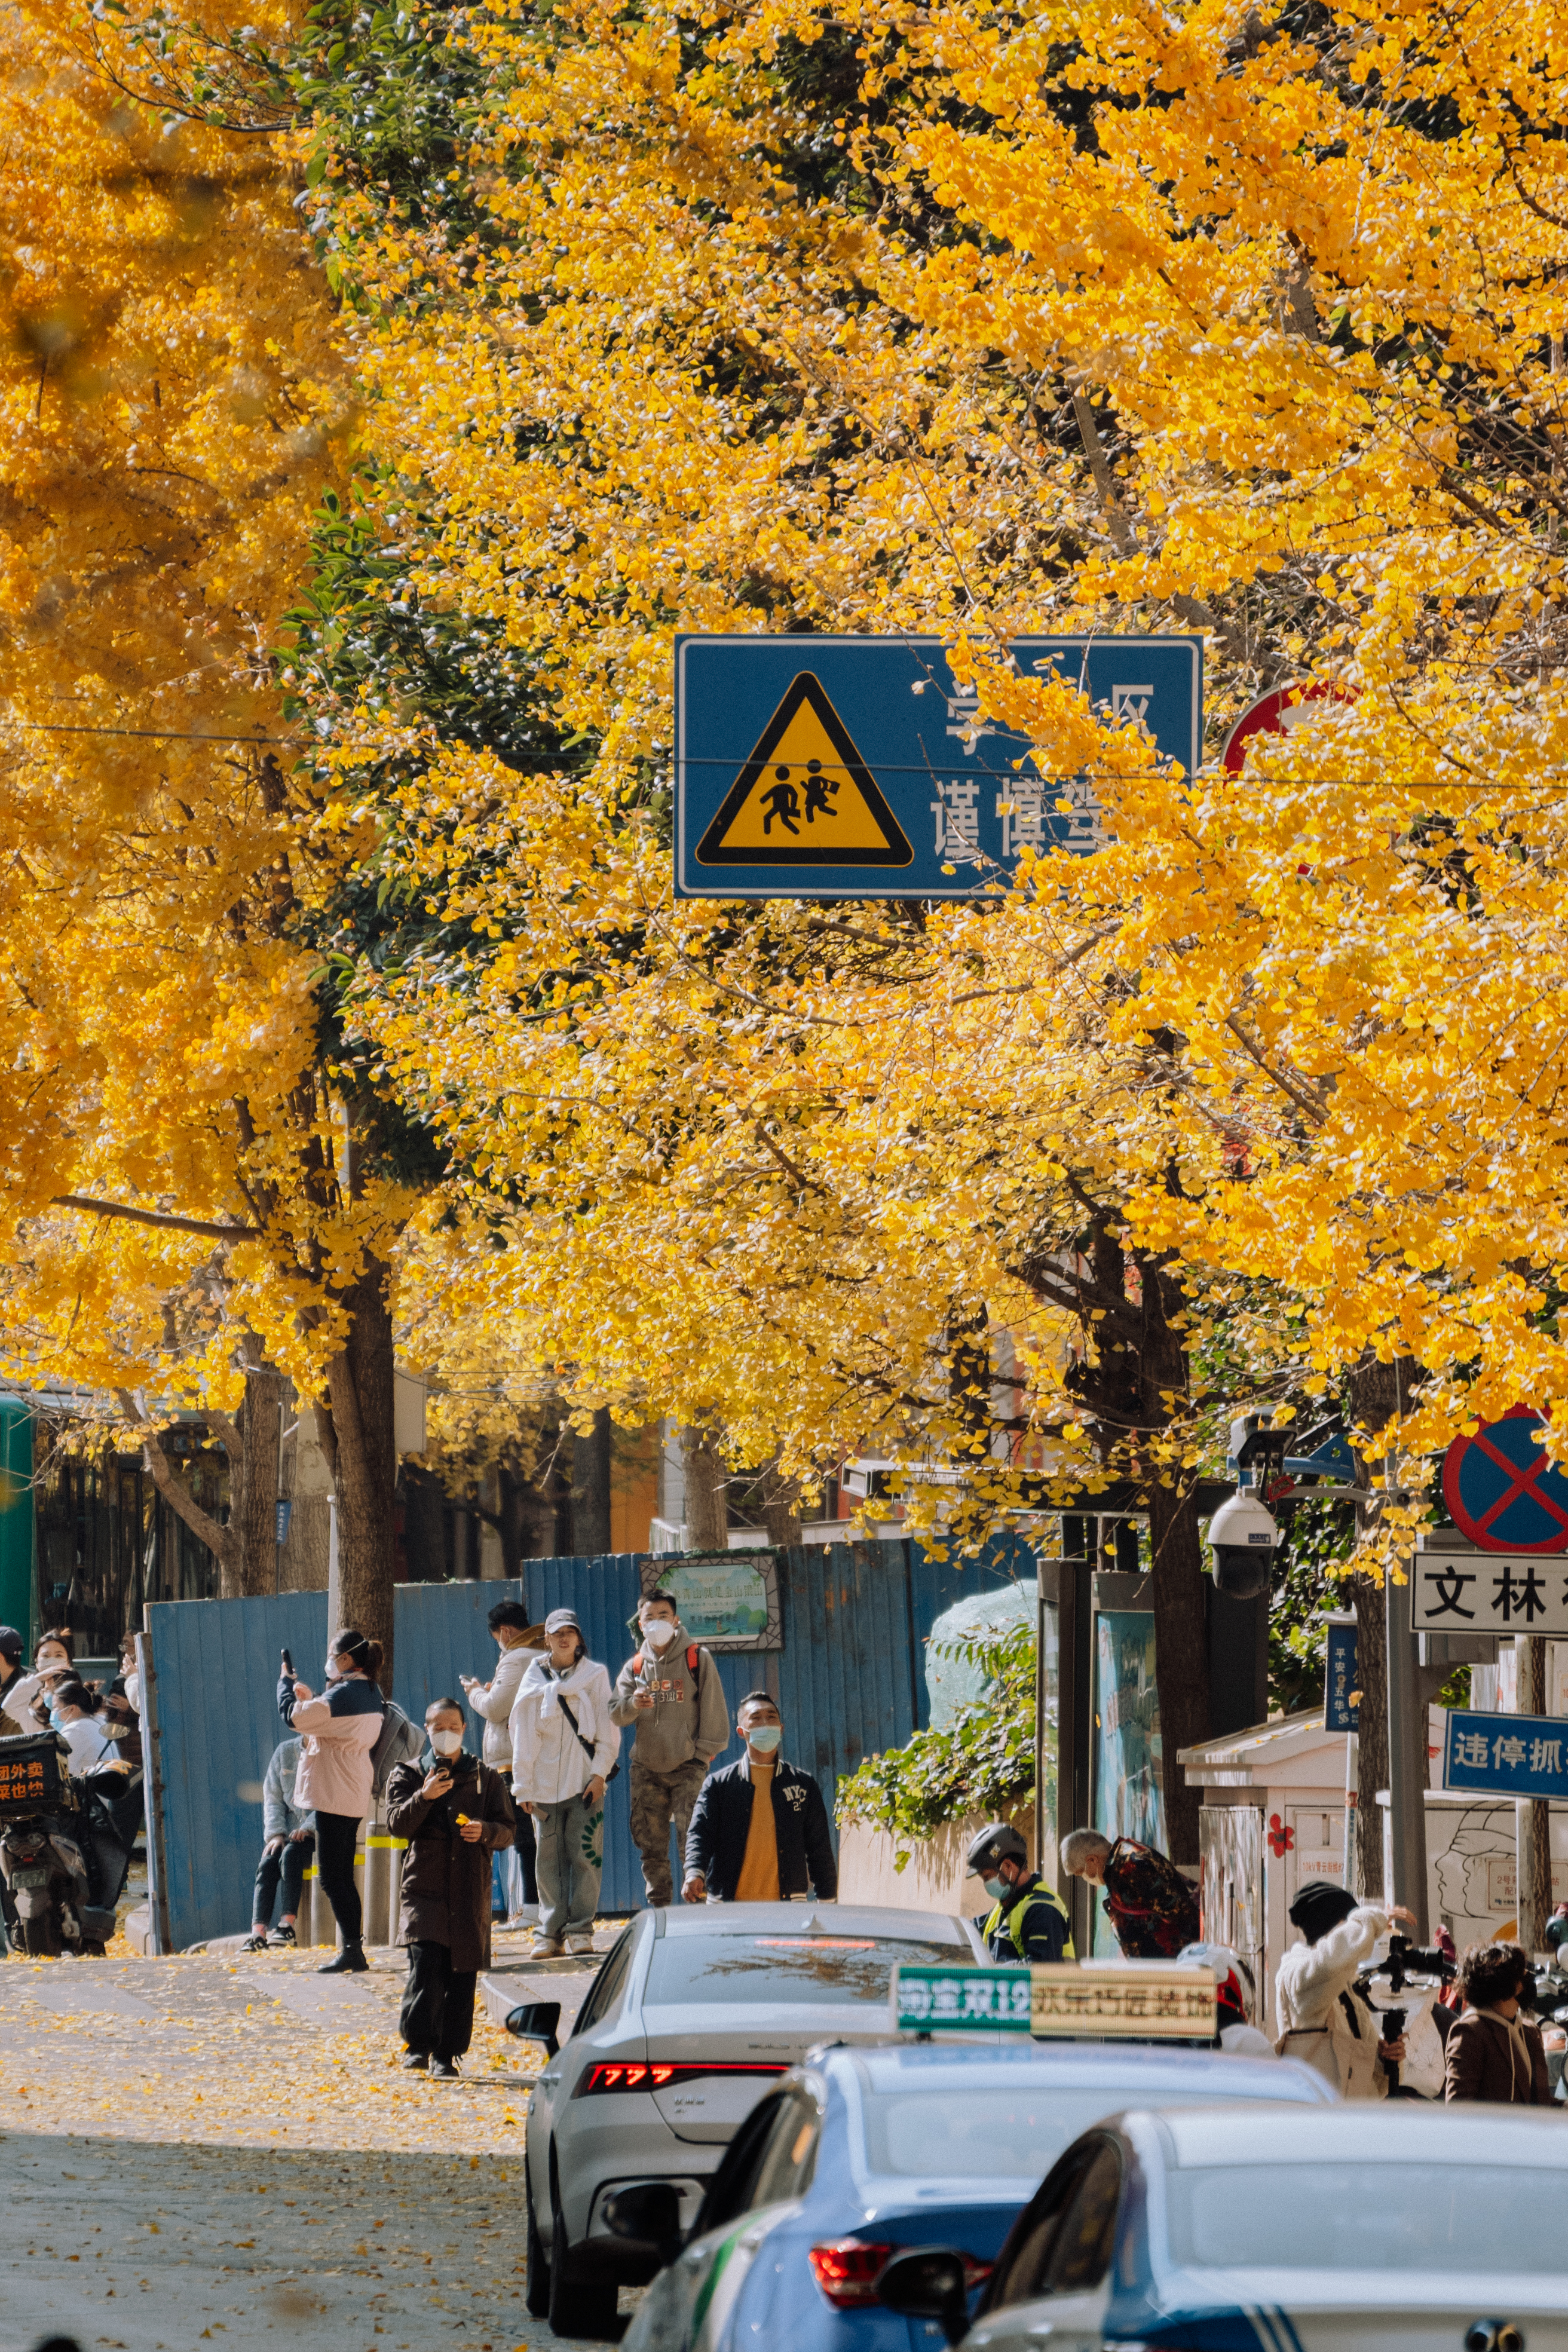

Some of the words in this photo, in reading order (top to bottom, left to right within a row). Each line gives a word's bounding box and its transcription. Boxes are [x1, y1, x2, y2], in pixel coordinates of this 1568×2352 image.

[946, 680, 1157, 755] 学区
[1424, 1565, 1568, 1623] 文林
[1454, 1732, 1568, 1774] 违停抓
[783, 1785, 807, 1802] NYC
